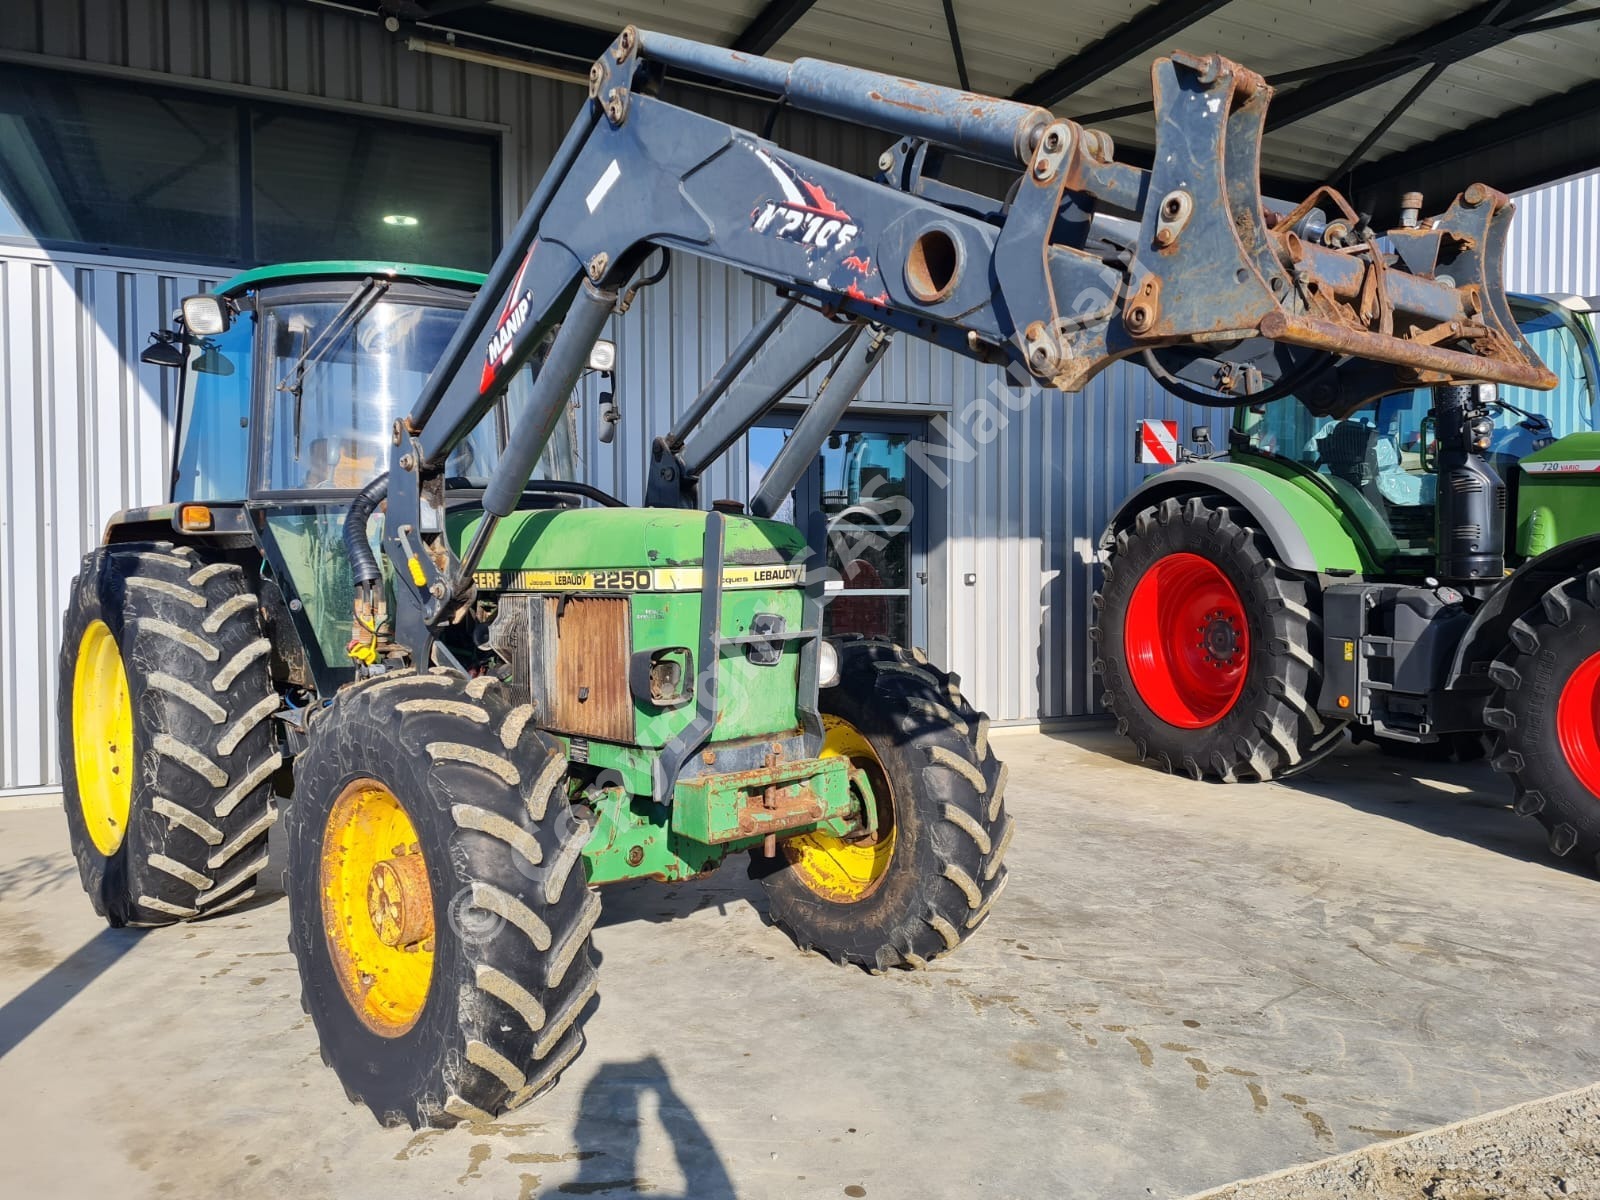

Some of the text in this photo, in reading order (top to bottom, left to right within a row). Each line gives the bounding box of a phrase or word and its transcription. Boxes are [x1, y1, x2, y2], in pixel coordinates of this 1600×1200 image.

[1541, 463, 1559, 471] 720
[554, 575, 587, 586] LEBAUDY
[592, 570, 651, 589] 2250
[754, 568, 798, 582] LEBAUDY
